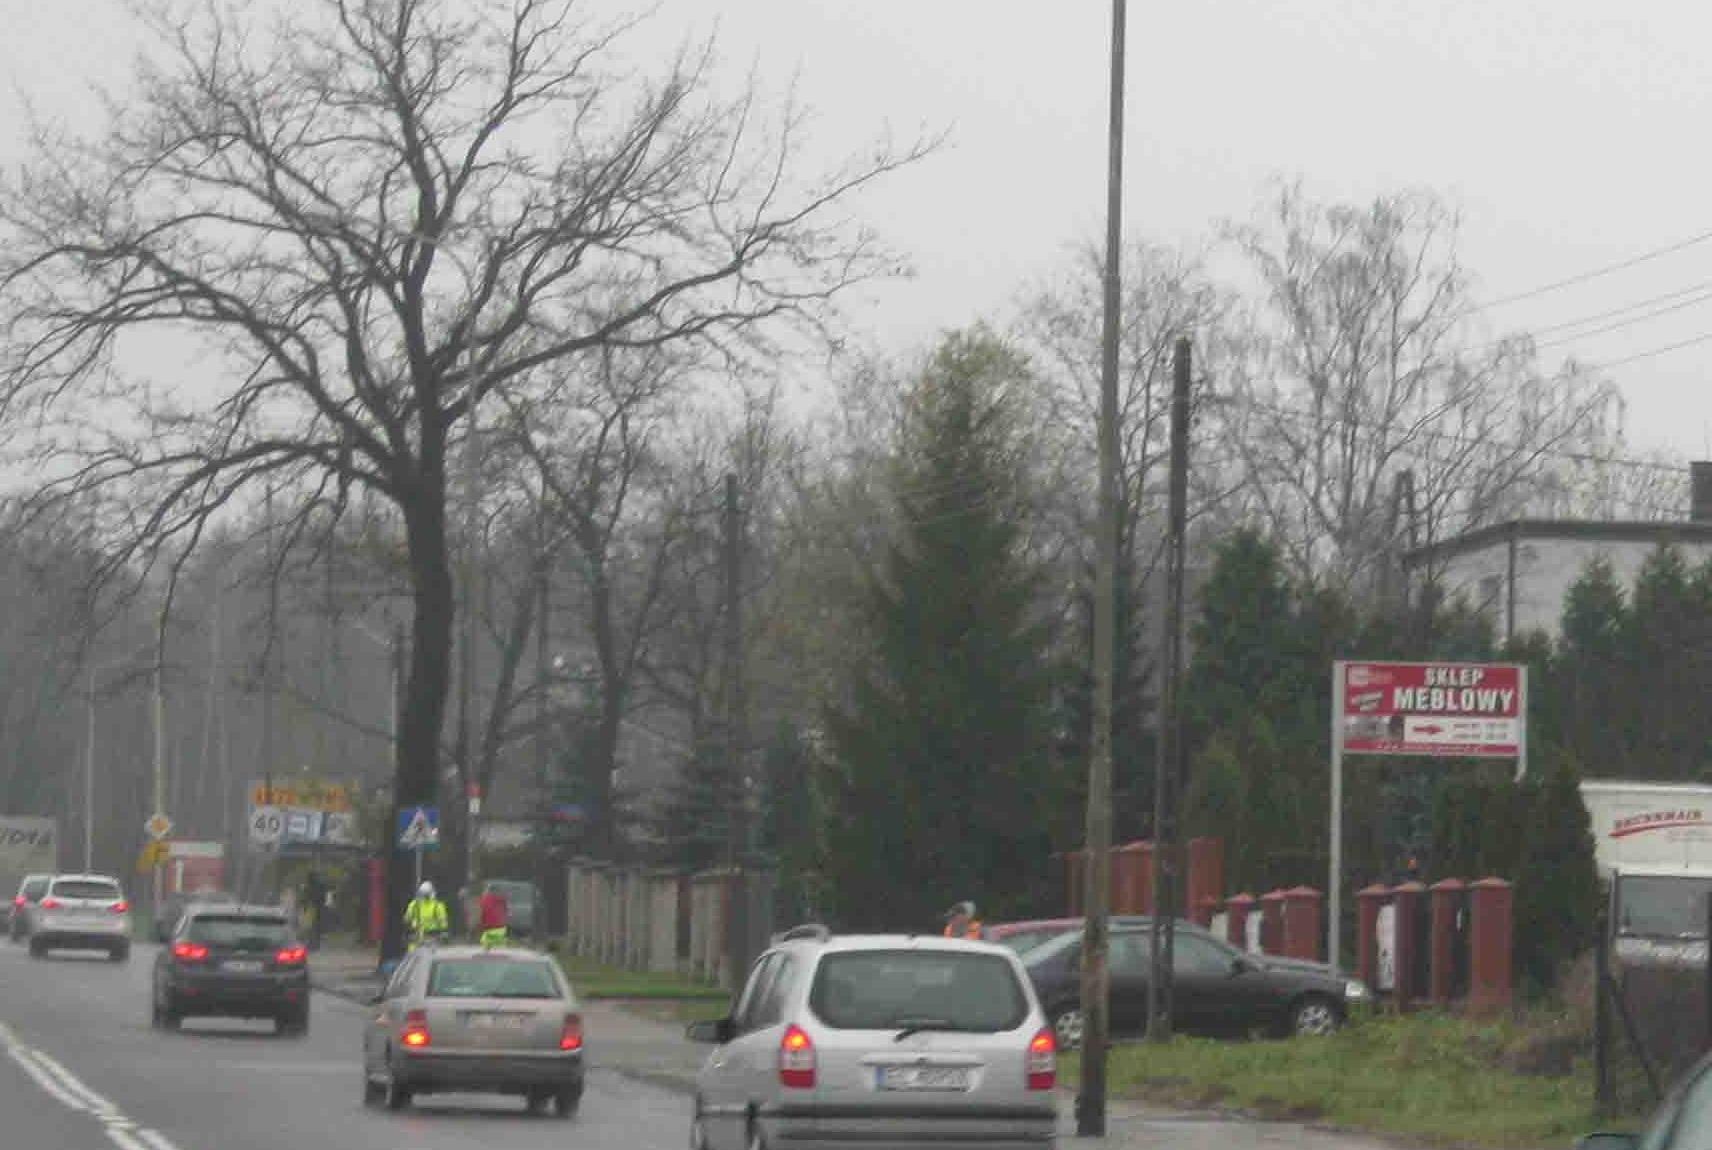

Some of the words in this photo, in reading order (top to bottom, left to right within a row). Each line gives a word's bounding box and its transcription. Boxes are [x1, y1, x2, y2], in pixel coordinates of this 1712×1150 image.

[1424, 667, 1484, 686] SKLEP
[1393, 686, 1514, 712] MEBLOWY
[255, 816, 281, 831] 40
